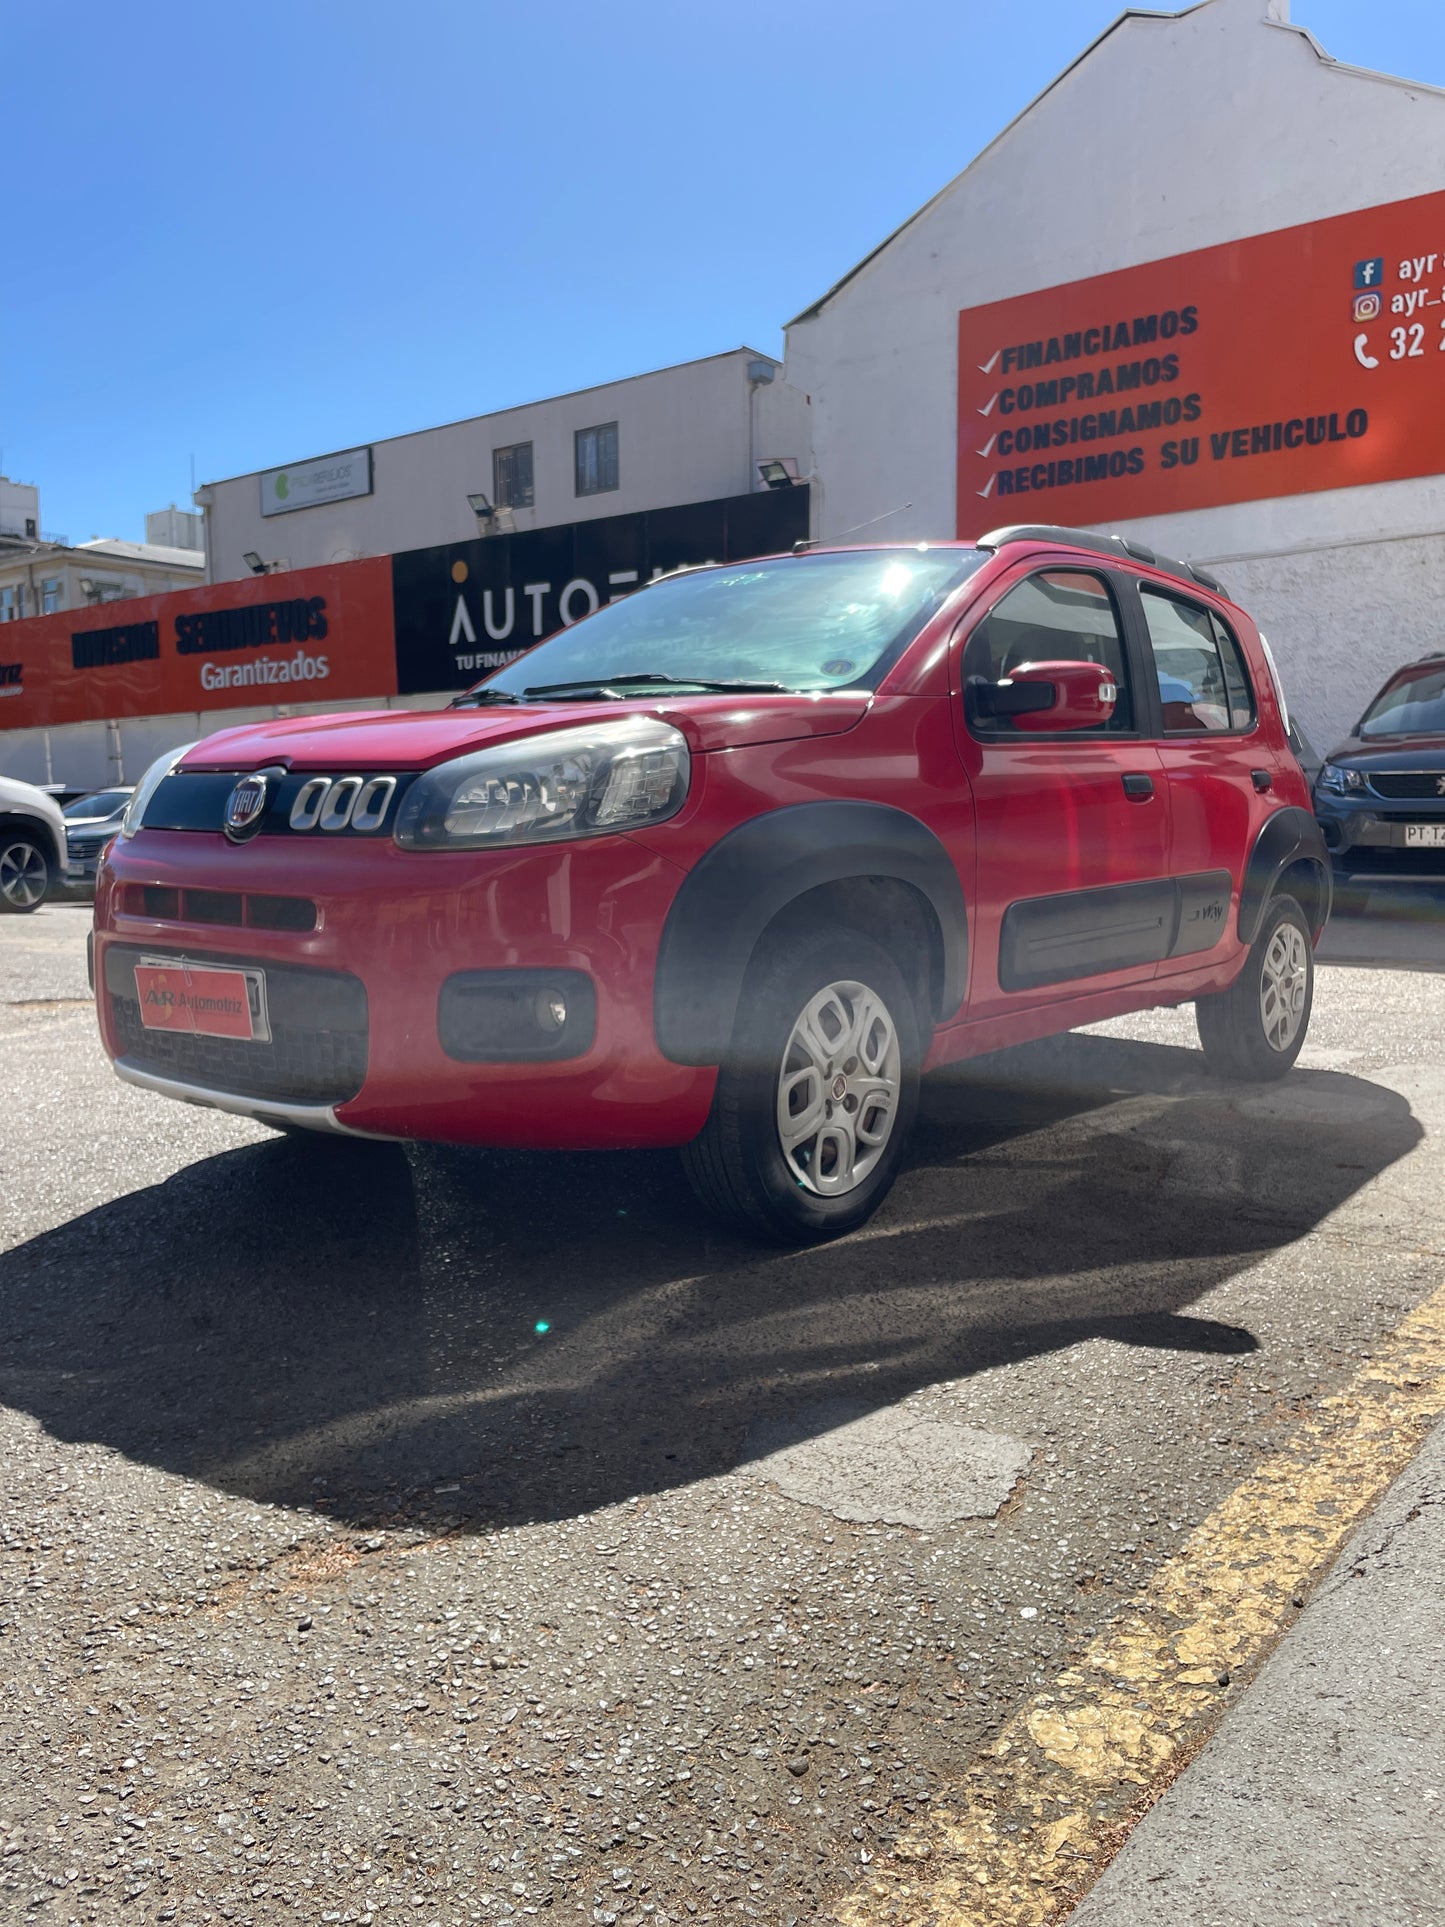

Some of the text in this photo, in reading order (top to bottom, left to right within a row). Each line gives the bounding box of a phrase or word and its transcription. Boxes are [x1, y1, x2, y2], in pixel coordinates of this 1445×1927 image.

[1399, 254, 1437, 283] ayr
[1391, 288, 1445, 318] ayr_
[1001, 306, 1198, 374] FINANCIAMOS
[1390, 323, 1424, 360] 32
[999, 354, 1179, 415] COMPRAMOS
[997, 393, 1201, 456] CONSIGNAMOS
[997, 408, 1368, 496] RECIBIMOS SU VEHICULO
[201, 649, 328, 690] Garantizados
[455, 655, 474, 671] TU
[233, 790, 258, 813] FIAT
[178, 991, 243, 1014] Automotriz
